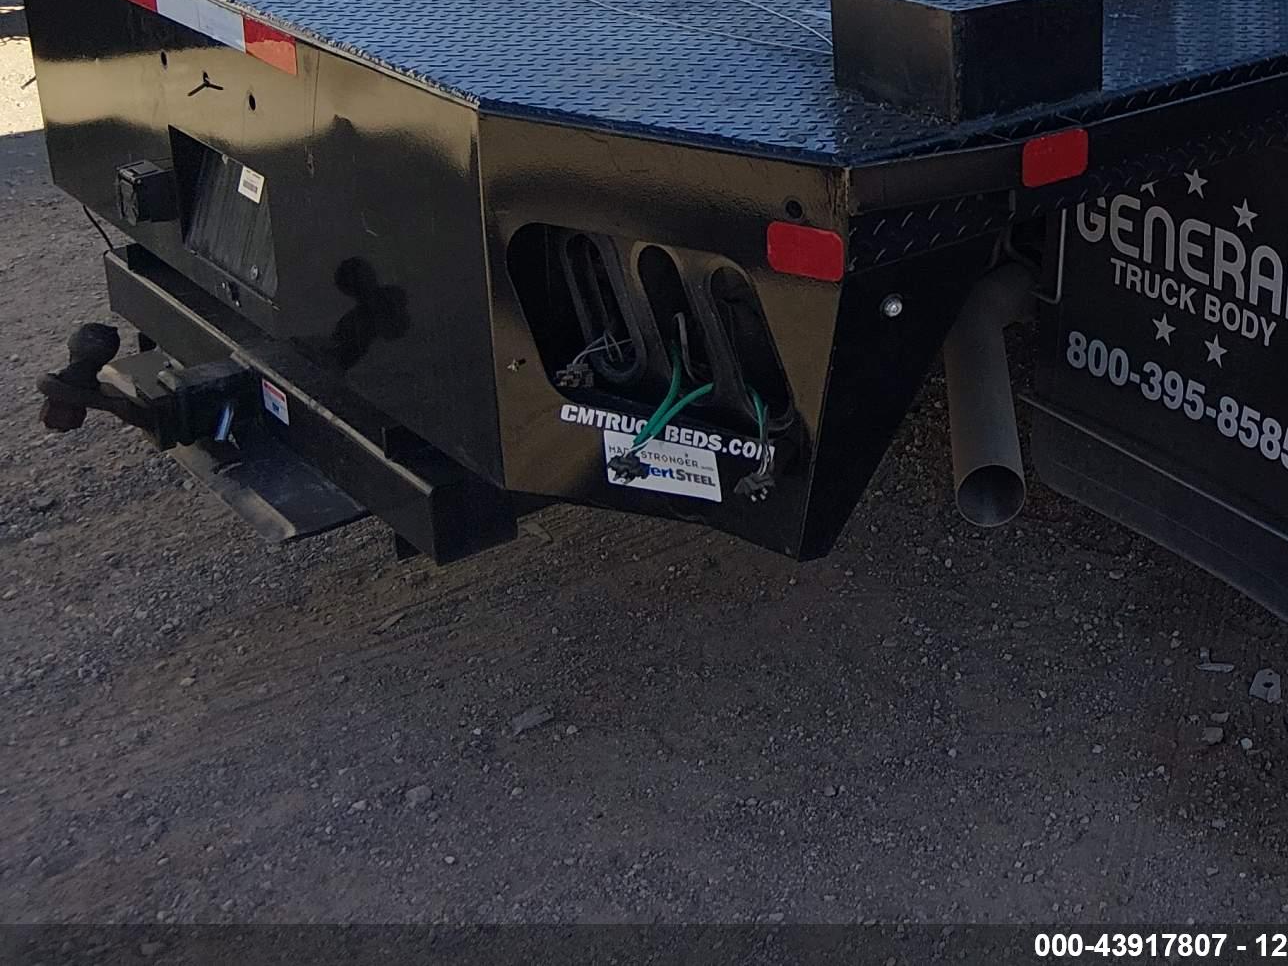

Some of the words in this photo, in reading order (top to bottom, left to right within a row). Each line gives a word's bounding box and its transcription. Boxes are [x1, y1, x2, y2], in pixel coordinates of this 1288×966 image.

[1110, 257, 1198, 316] TRUCK
[1203, 292, 1277, 347] BODY
[640, 449, 699, 469] STRONGER
